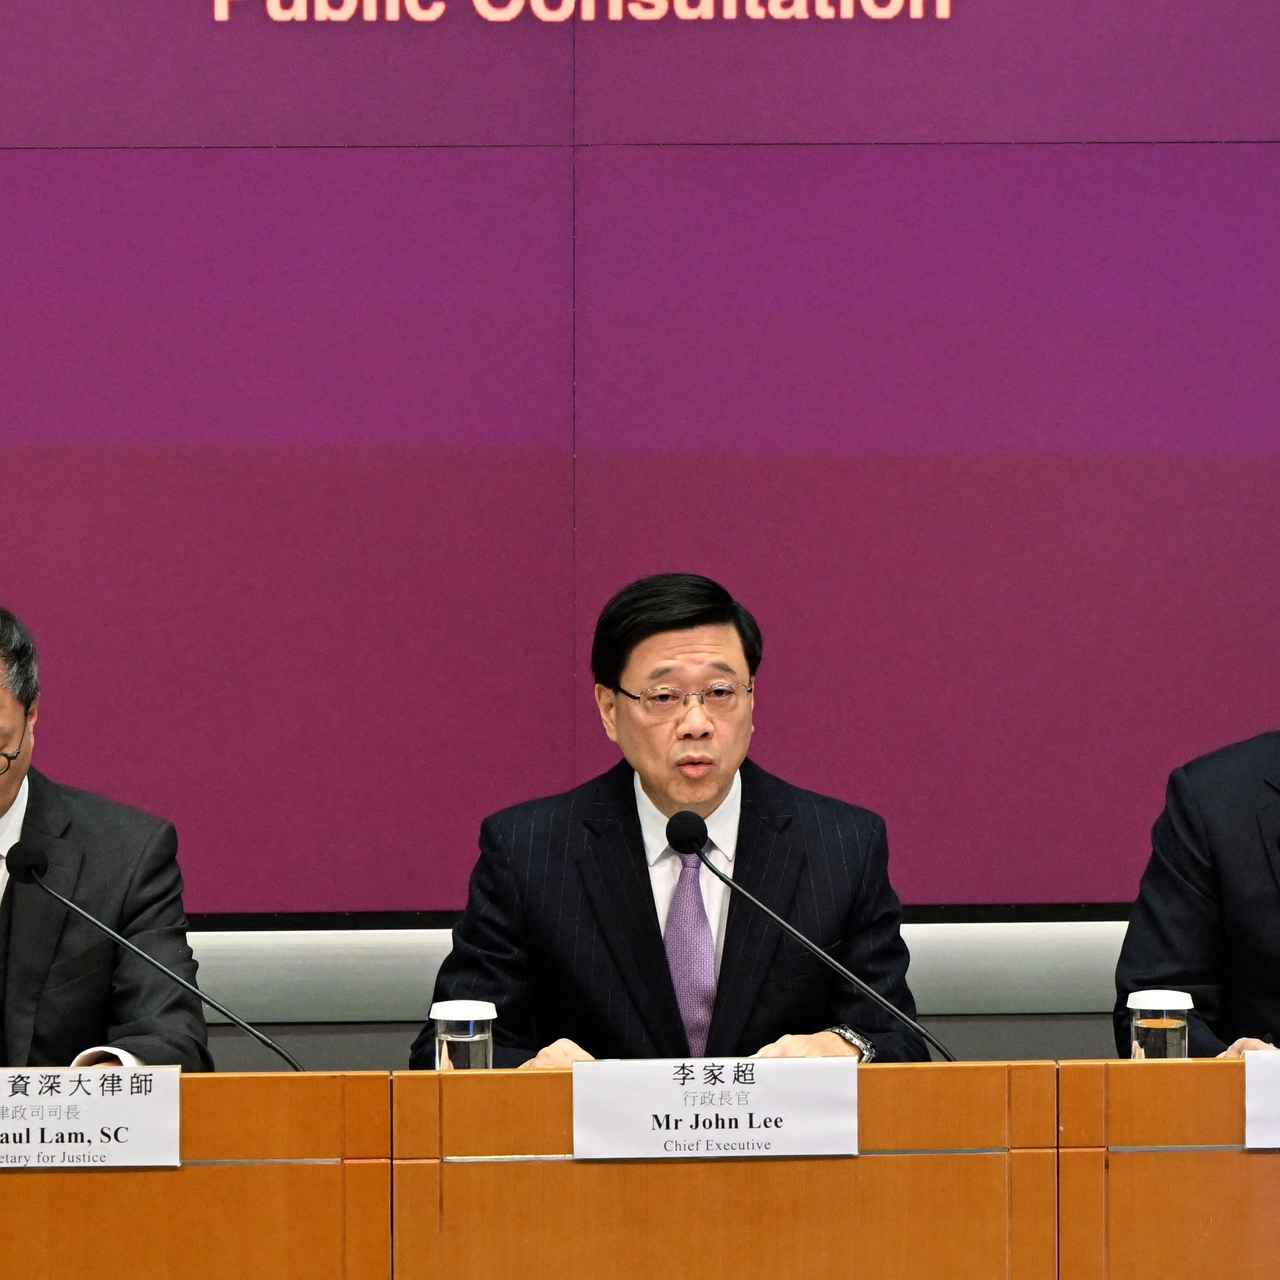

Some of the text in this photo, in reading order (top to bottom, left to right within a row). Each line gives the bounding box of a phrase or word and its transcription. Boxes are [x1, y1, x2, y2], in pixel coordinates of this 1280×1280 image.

[672, 1062, 756, 1087] 李家超
[682, 1090, 751, 1107] 行政長官
[651, 1112, 784, 1131] Mr John Lee
[39, 1127, 93, 1147] Lam,
[99, 1126, 129, 1145] SC
[663, 1138, 772, 1152] Chief Executive
[36, 1151, 56, 1164] for
[60, 1150, 107, 1164] Justice
